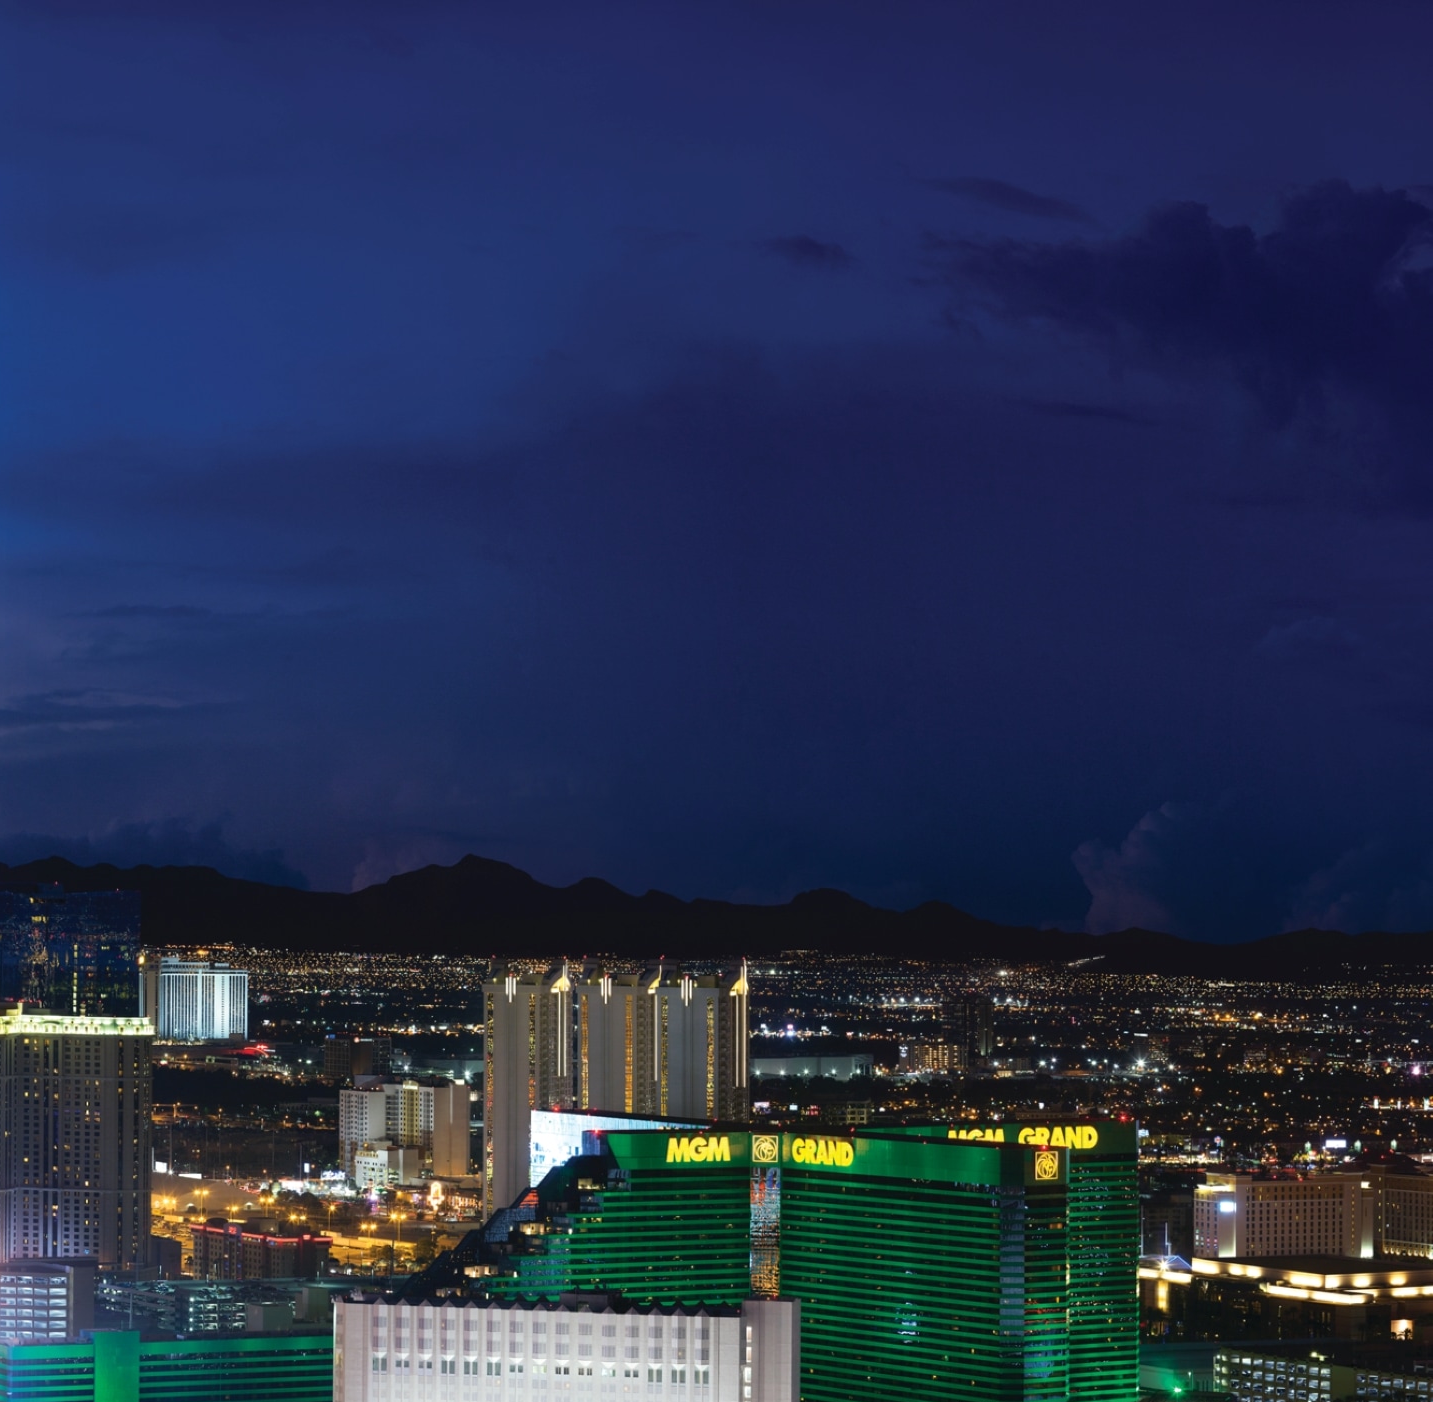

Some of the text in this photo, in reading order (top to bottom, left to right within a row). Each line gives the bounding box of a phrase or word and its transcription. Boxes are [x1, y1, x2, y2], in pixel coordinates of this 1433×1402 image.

[1018, 1125, 1099, 1149] GRAND
[666, 1136, 854, 1167] MGM GRAND
